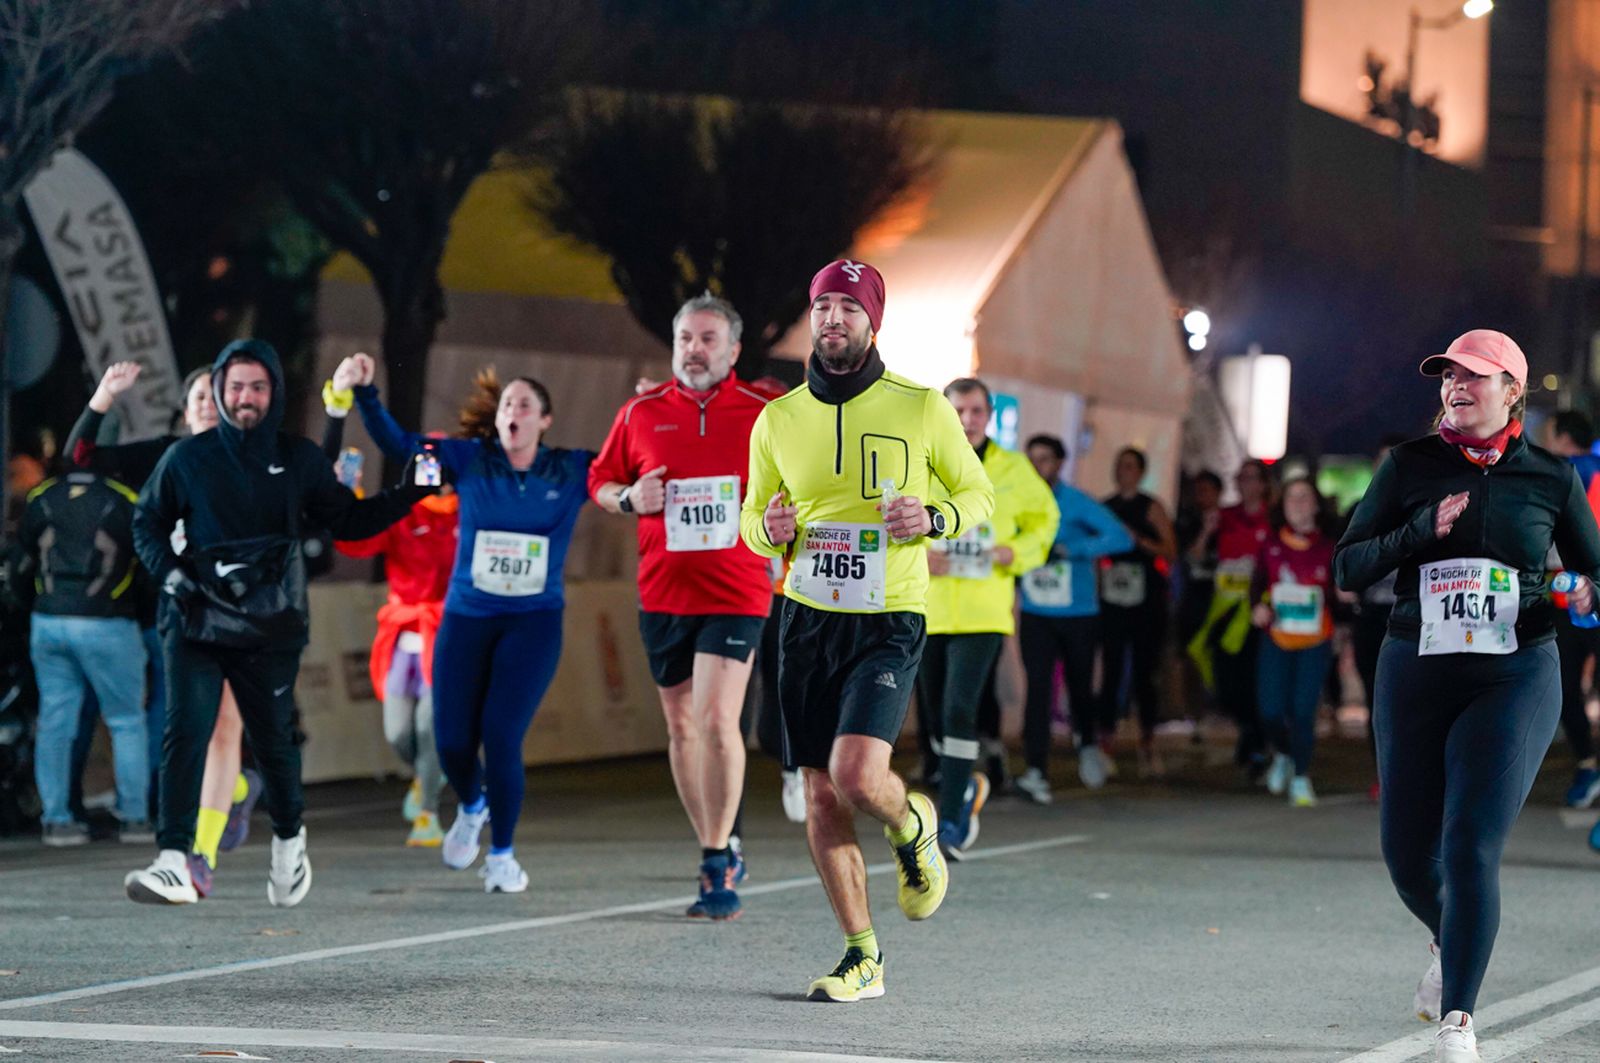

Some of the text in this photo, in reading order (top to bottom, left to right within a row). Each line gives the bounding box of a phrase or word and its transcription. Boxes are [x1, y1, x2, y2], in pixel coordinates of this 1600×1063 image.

[681, 504, 726, 526] 4108
[814, 530, 851, 541] NOCHE DE
[806, 540, 821, 551] SAN
[489, 556, 532, 575] 2607
[812, 552, 866, 580] 1465
[1440, 569, 1482, 580] NOCHE DE
[826, 580, 846, 588] Daniel
[1430, 583, 1449, 594] SAN
[1440, 592, 1497, 622] 1464
